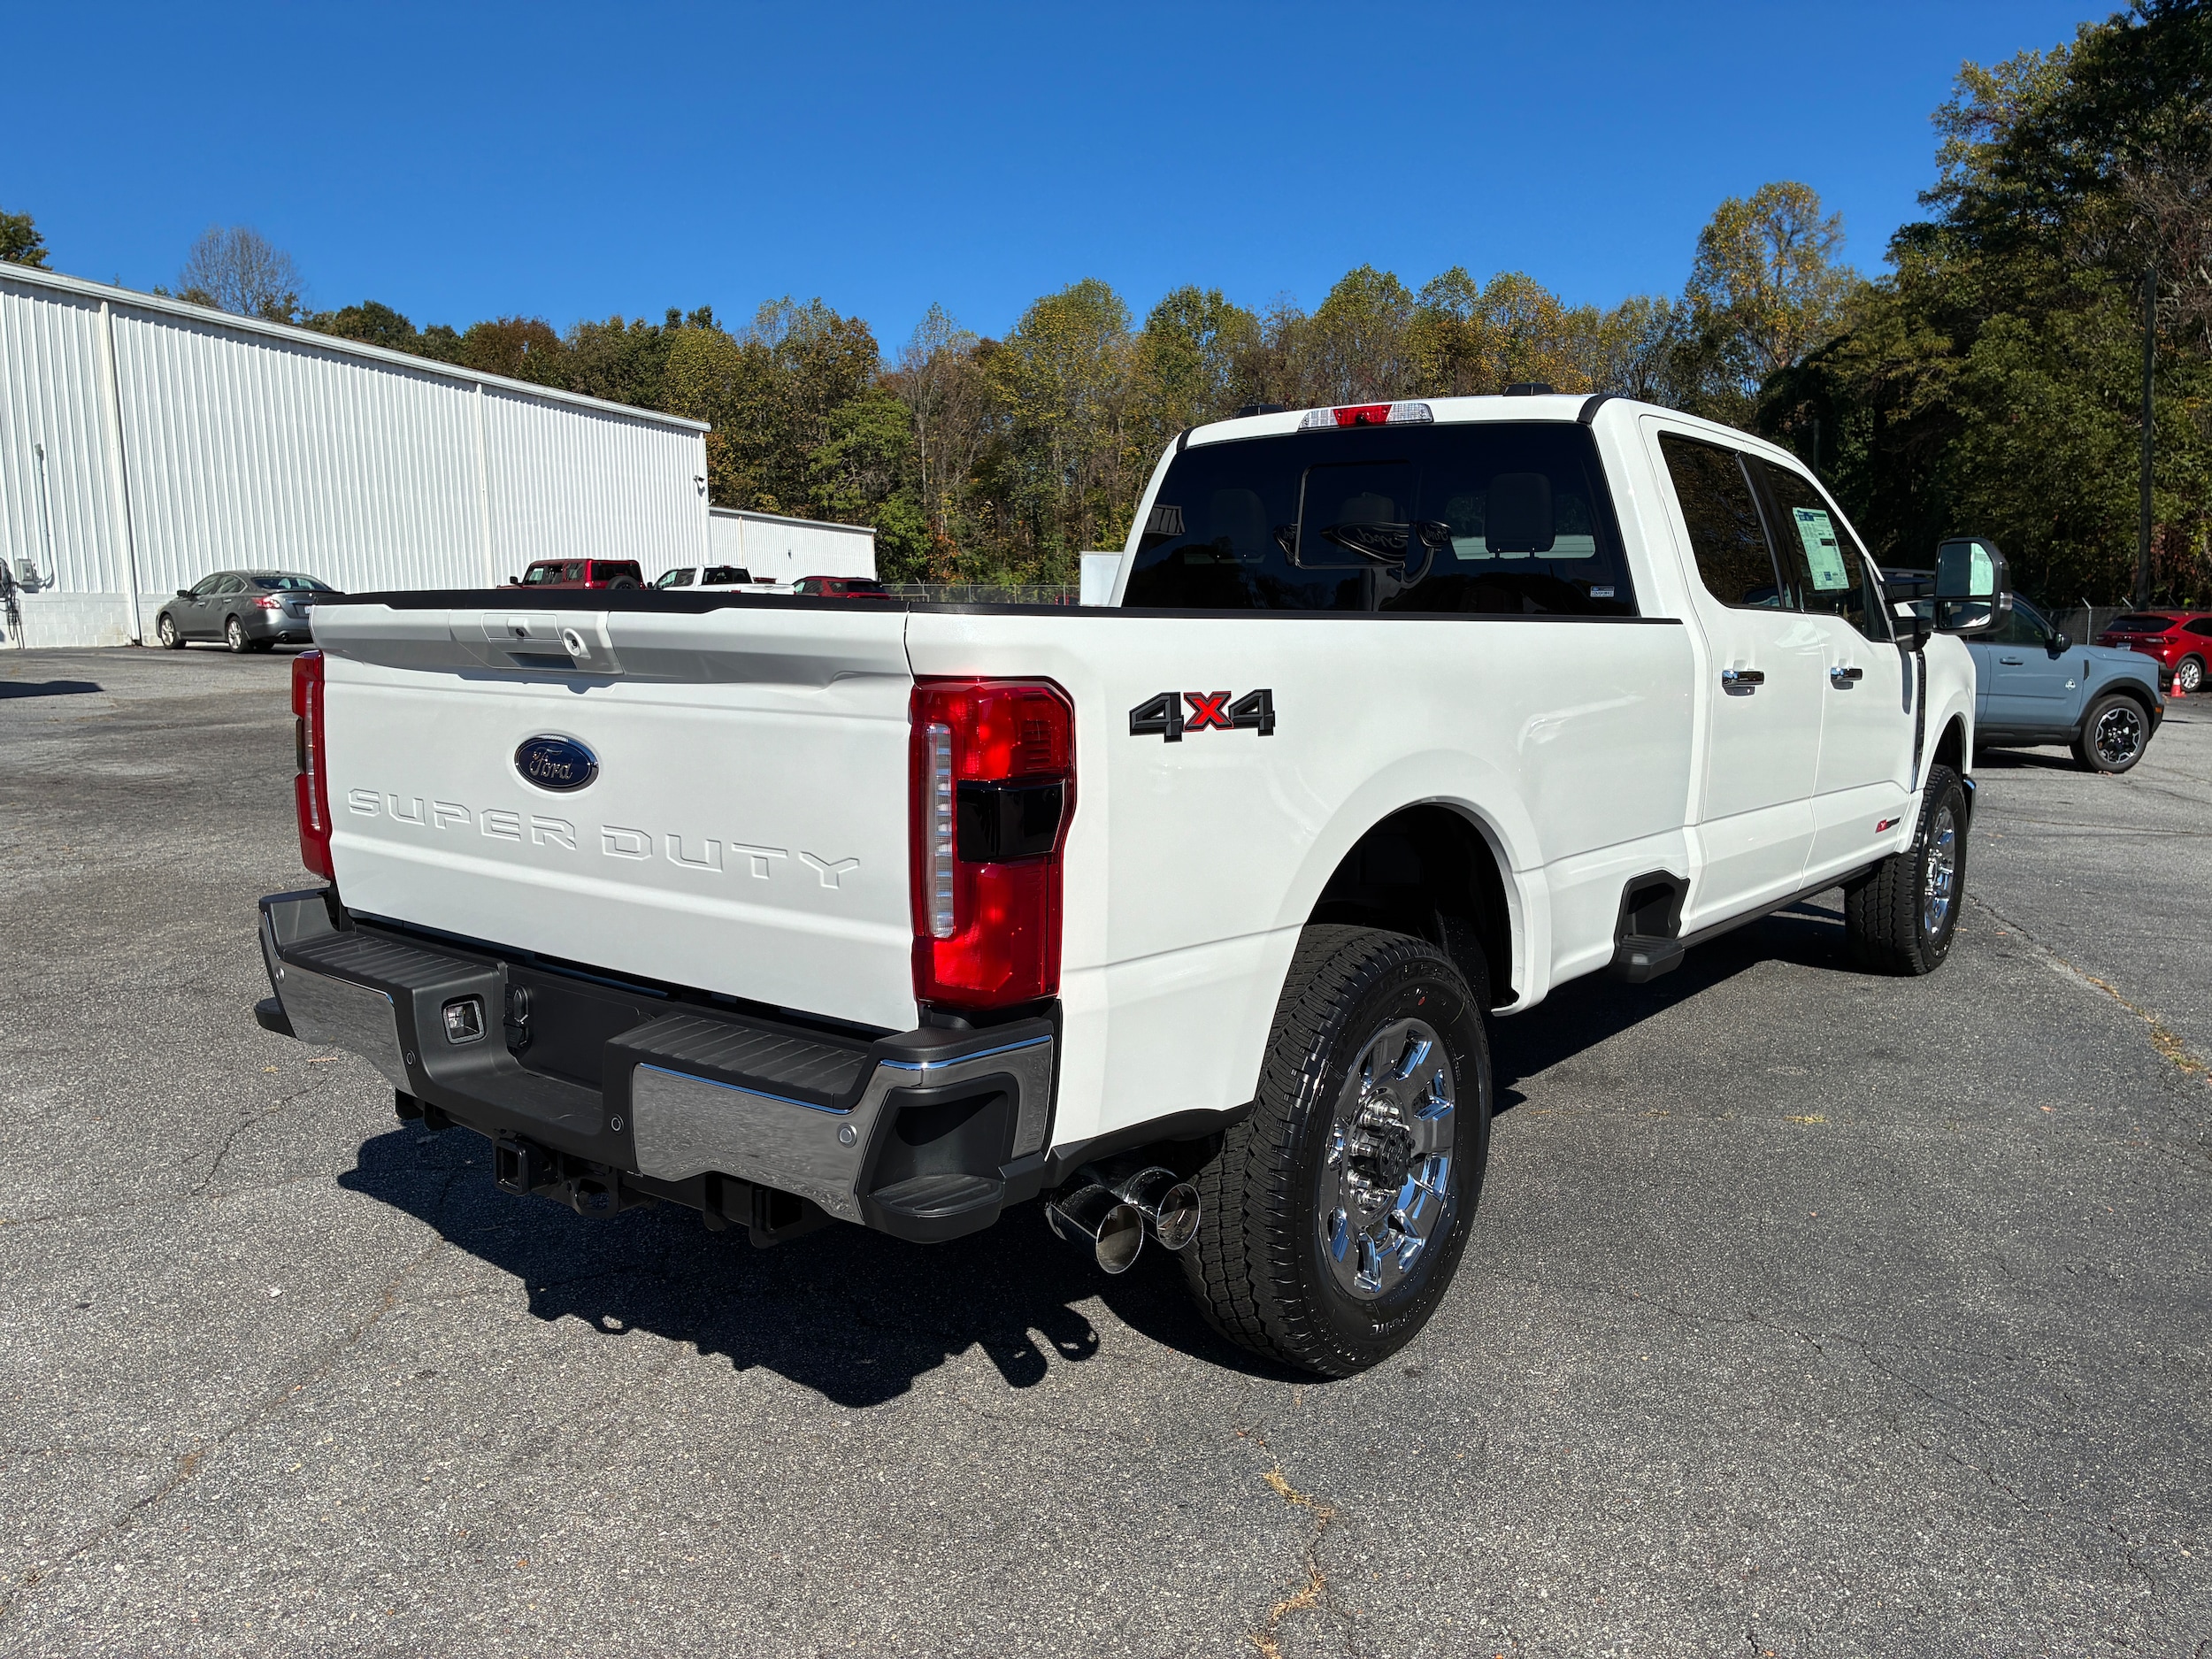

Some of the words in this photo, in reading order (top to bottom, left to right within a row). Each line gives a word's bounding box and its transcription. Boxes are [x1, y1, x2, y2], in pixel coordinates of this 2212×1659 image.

[529, 746, 573, 780] Ford
[348, 787, 577, 850] SUPER
[601, 825, 860, 889] DUTY
